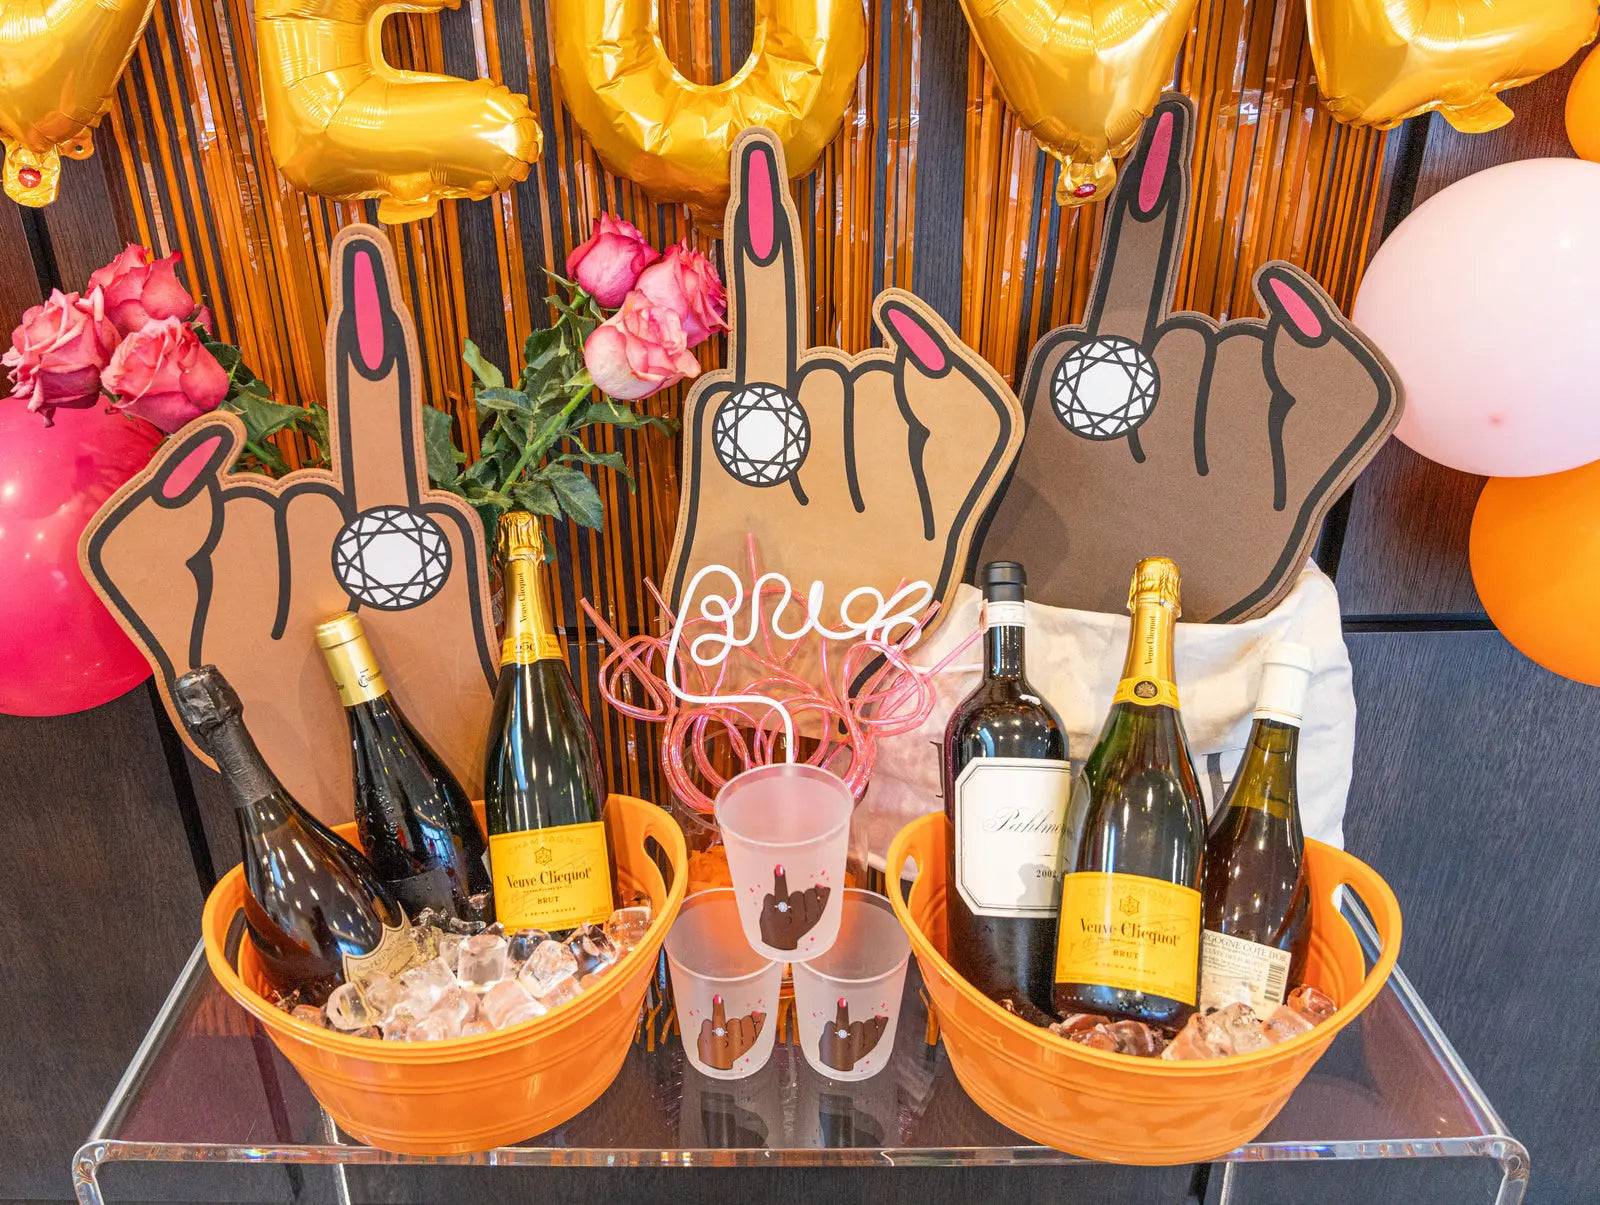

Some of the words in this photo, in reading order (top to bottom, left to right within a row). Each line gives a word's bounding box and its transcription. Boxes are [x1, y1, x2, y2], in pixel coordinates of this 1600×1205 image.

[506, 871, 538, 889] Veuve
[540, 867, 591, 885] Clicquot
[537, 895, 560, 905] BRUT
[1080, 918, 1117, 935] Veuve
[1121, 921, 1178, 947] Clicquot
[1112, 949, 1140, 960] BRUT
